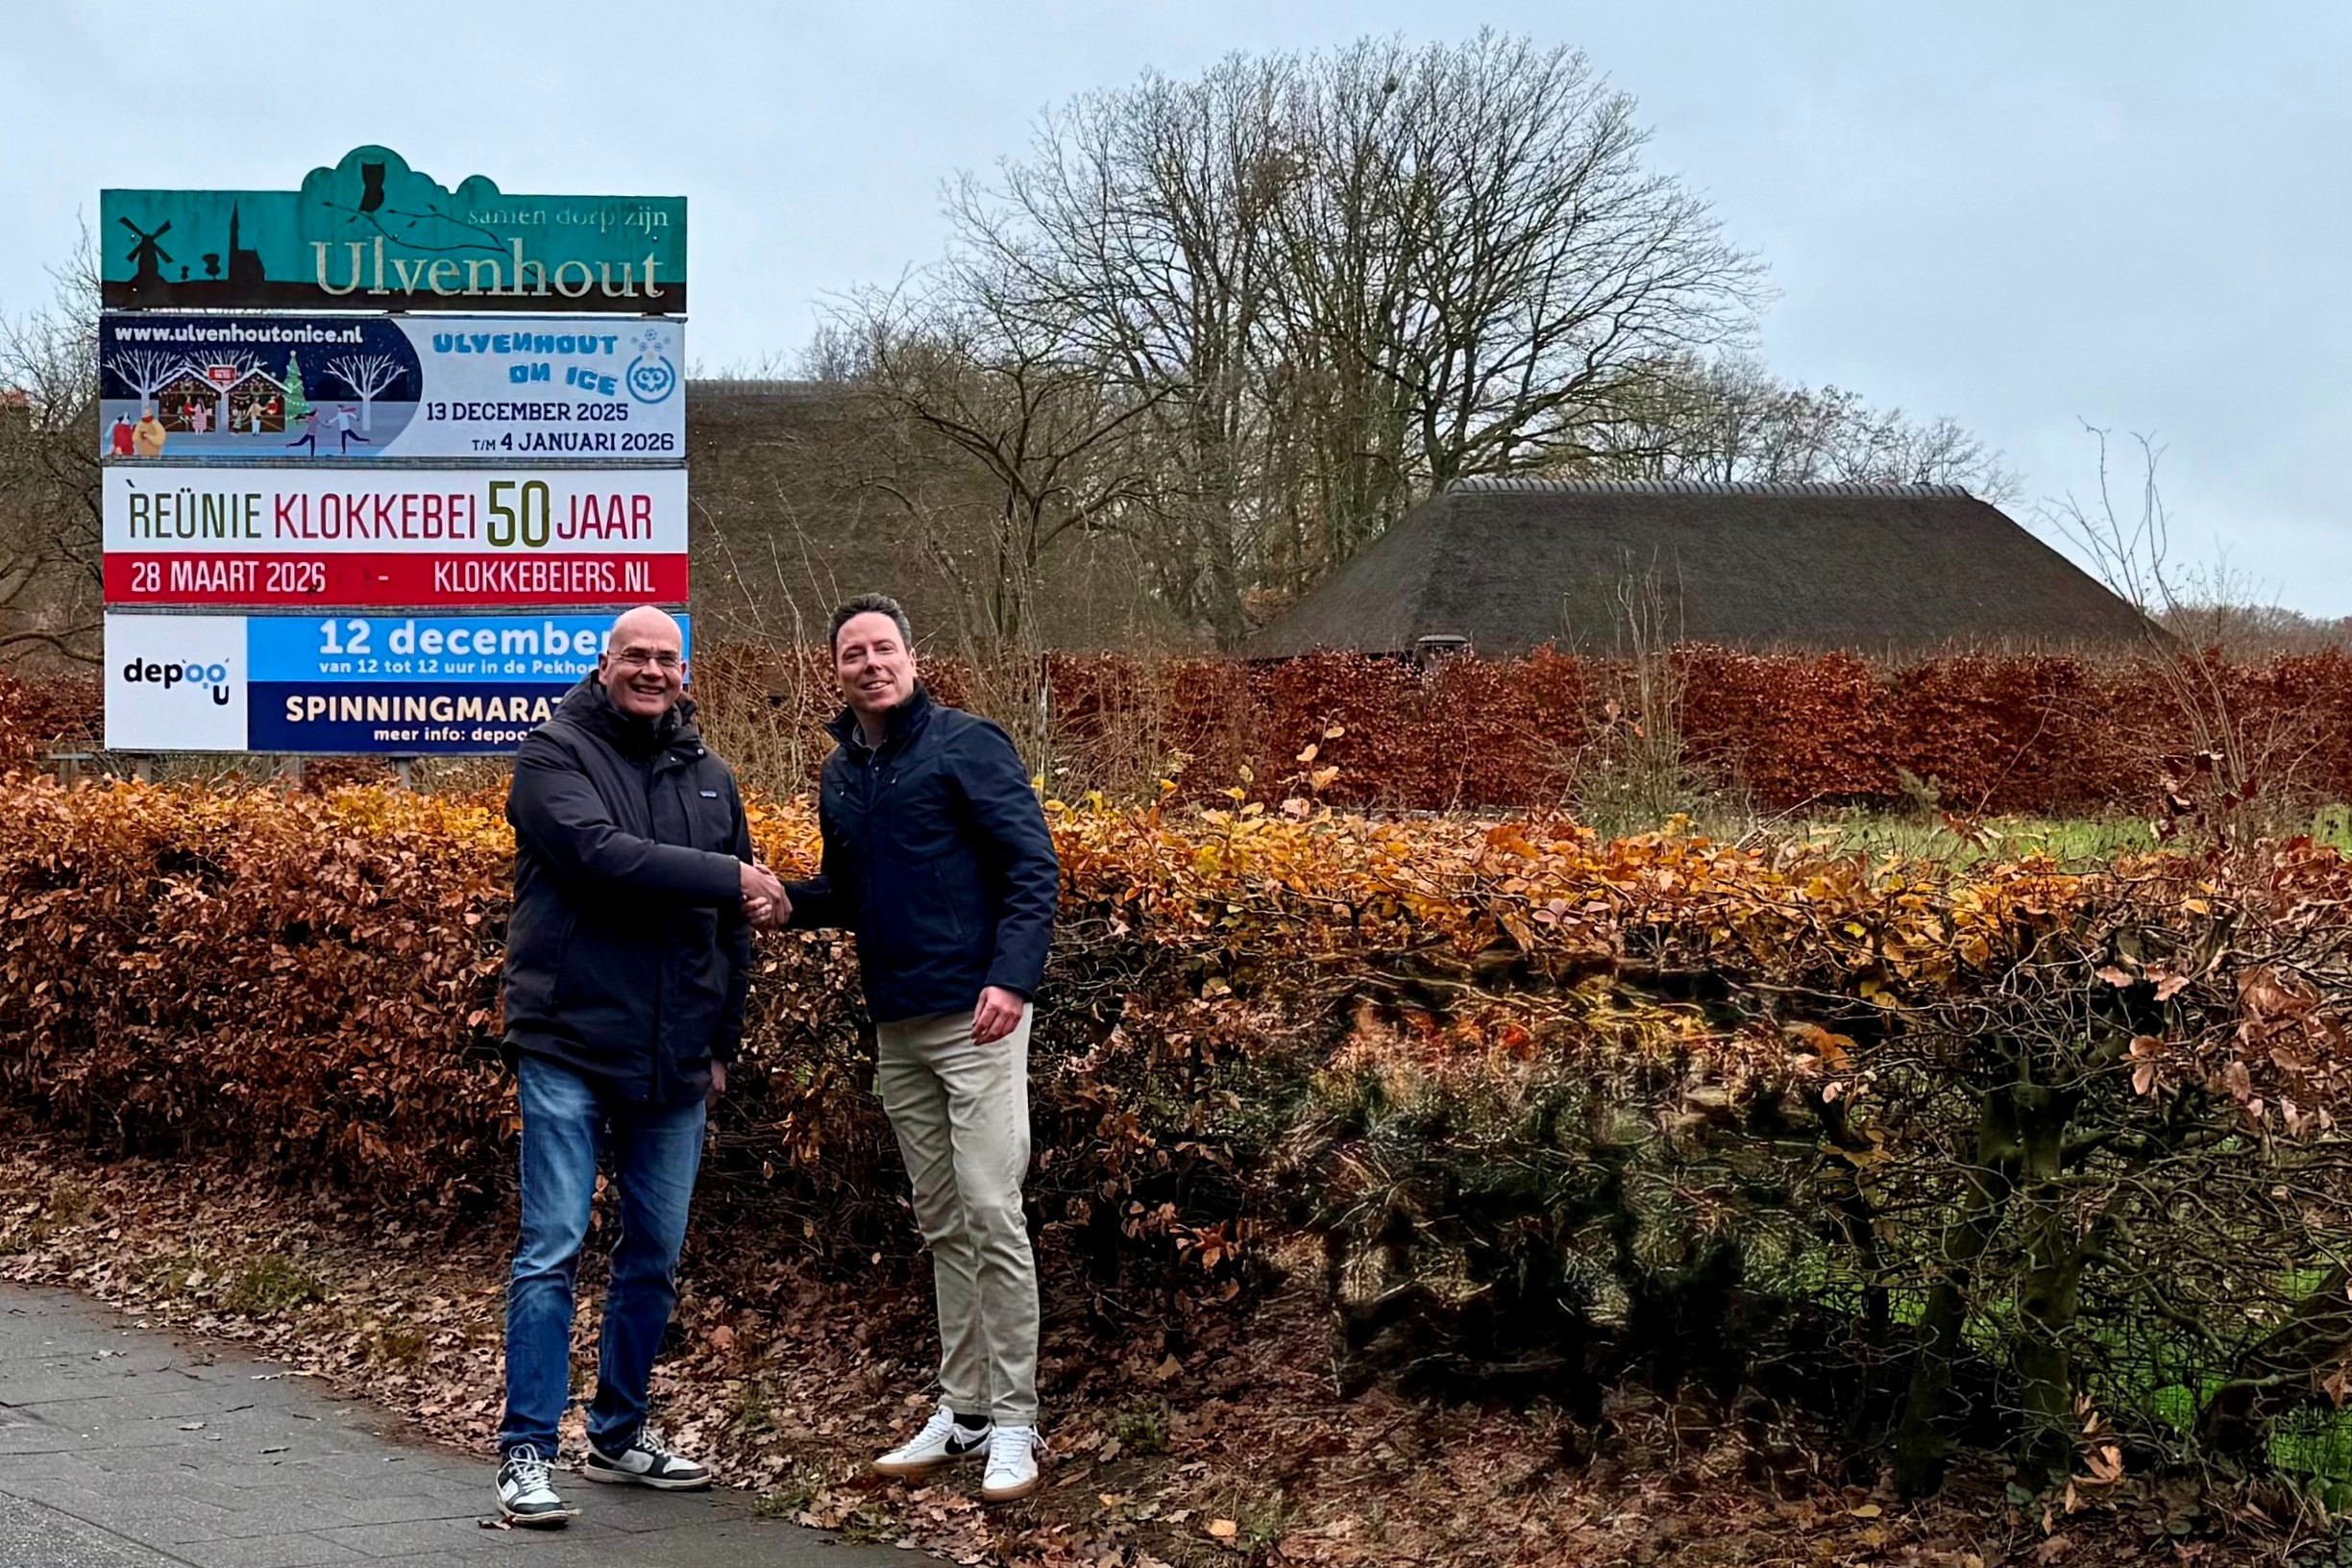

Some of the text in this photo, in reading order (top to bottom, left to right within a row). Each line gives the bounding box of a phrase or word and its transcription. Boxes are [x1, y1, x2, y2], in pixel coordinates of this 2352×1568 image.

[468, 204, 670, 234] samen dorp zijn
[308, 235, 665, 300] Ulvenhout
[114, 323, 363, 343] www.ulvenhoutonice.nl
[432, 331, 618, 355] ULVENHOUT
[509, 362, 618, 397] ON ICE
[427, 402, 629, 421] 13 DECEMBER 2025
[472, 432, 674, 452] T/M 4 JANUARI 2026
[275, 493, 476, 539] KLOKKEBEI
[487, 479, 551, 548] 50
[557, 494, 651, 540] JAAR
[131, 561, 160, 592] 28
[170, 560, 259, 592] MAART
[266, 561, 326, 593] 2026
[434, 560, 656, 593] KLOKKEBEIERS.NL
[319, 619, 371, 655] 12
[319, 661, 352, 673] van
[357, 659, 378, 673] 12
[384, 659, 412, 674] tot
[418, 659, 438, 674] 12
[444, 662, 476, 674] uur
[481, 659, 499, 674] in
[503, 659, 527, 674] de
[374, 728, 419, 742] meer
[425, 726, 466, 742] info:
